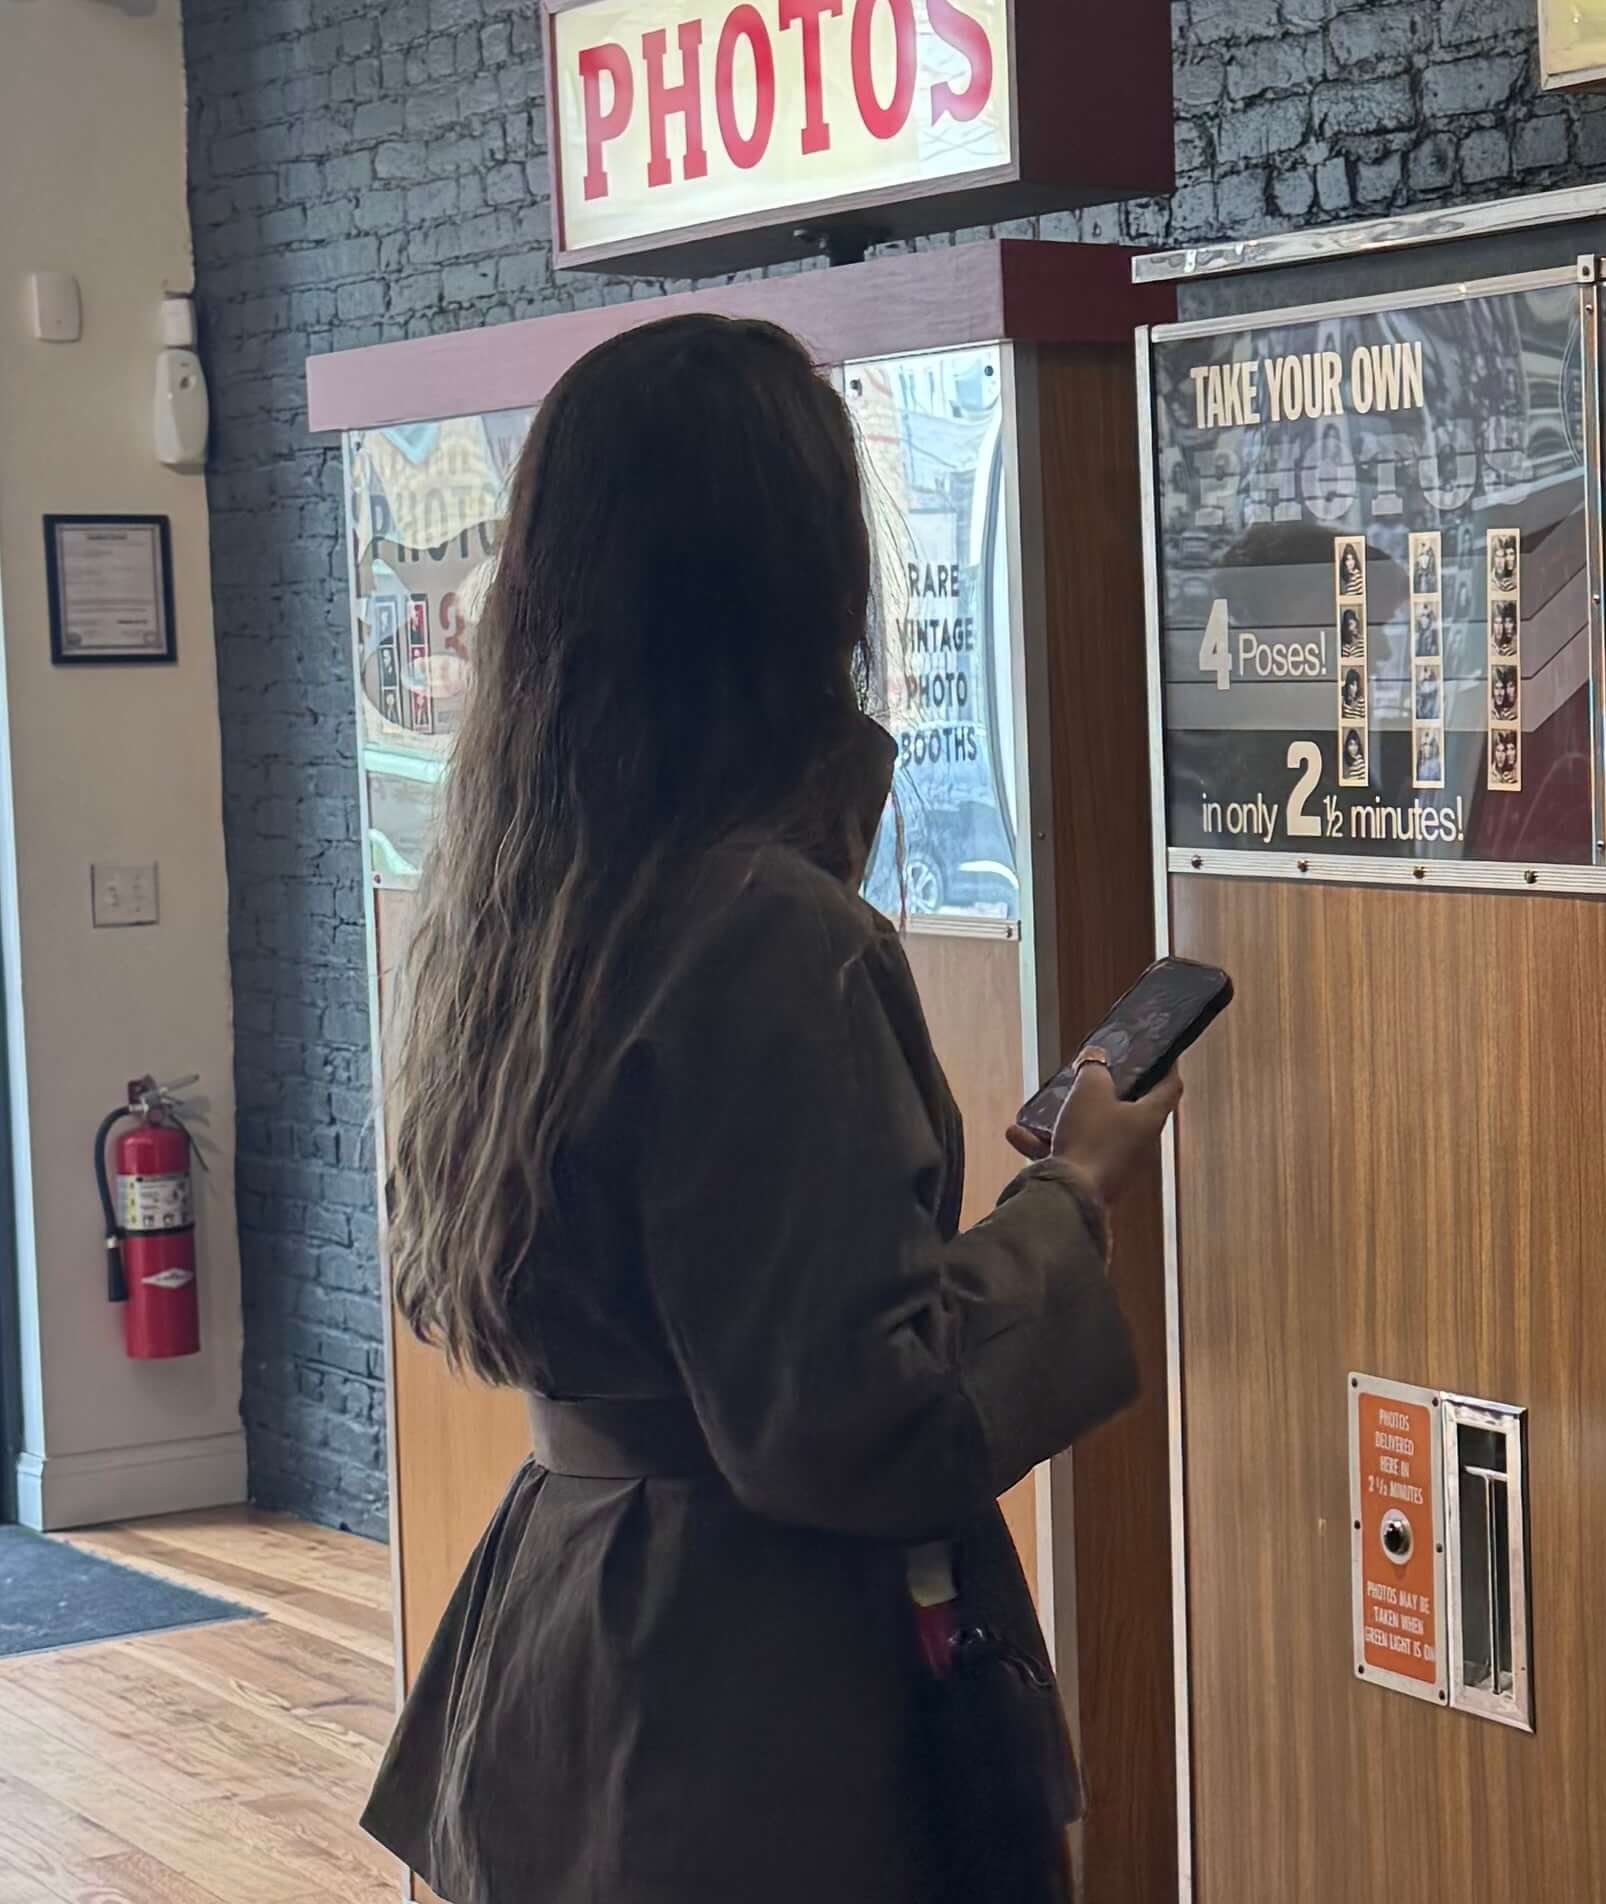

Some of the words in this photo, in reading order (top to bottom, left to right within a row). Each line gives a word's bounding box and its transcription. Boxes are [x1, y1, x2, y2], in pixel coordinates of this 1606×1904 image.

[1190, 360, 1260, 429] TAKE
[1264, 350, 1343, 421] YOUR
[1351, 341, 1424, 414] OWN
[908, 562, 960, 598] RARE
[896, 617, 974, 654] VINTAGE
[1199, 598, 1232, 690] 4
[1238, 631, 1328, 676] Poses!
[904, 672, 968, 709] PHOTO
[899, 727, 977, 769] BOOTHS
[1202, 793, 1223, 833] in
[1227, 792, 1279, 844] only
[1351, 795, 1465, 841] minutes!
[1378, 1408, 1409, 1432] PHOTOS
[1375, 1431, 1414, 1456] DELIVERED
[1390, 1480, 1424, 1505] MINUTES
[1367, 1580, 1397, 1605] PHOTOS
[1399, 1589, 1418, 1610] MAY
[1419, 1595, 1431, 1614] BE
[1373, 1605, 1399, 1628] TAKEN
[1400, 1614, 1425, 1636] WHEN
